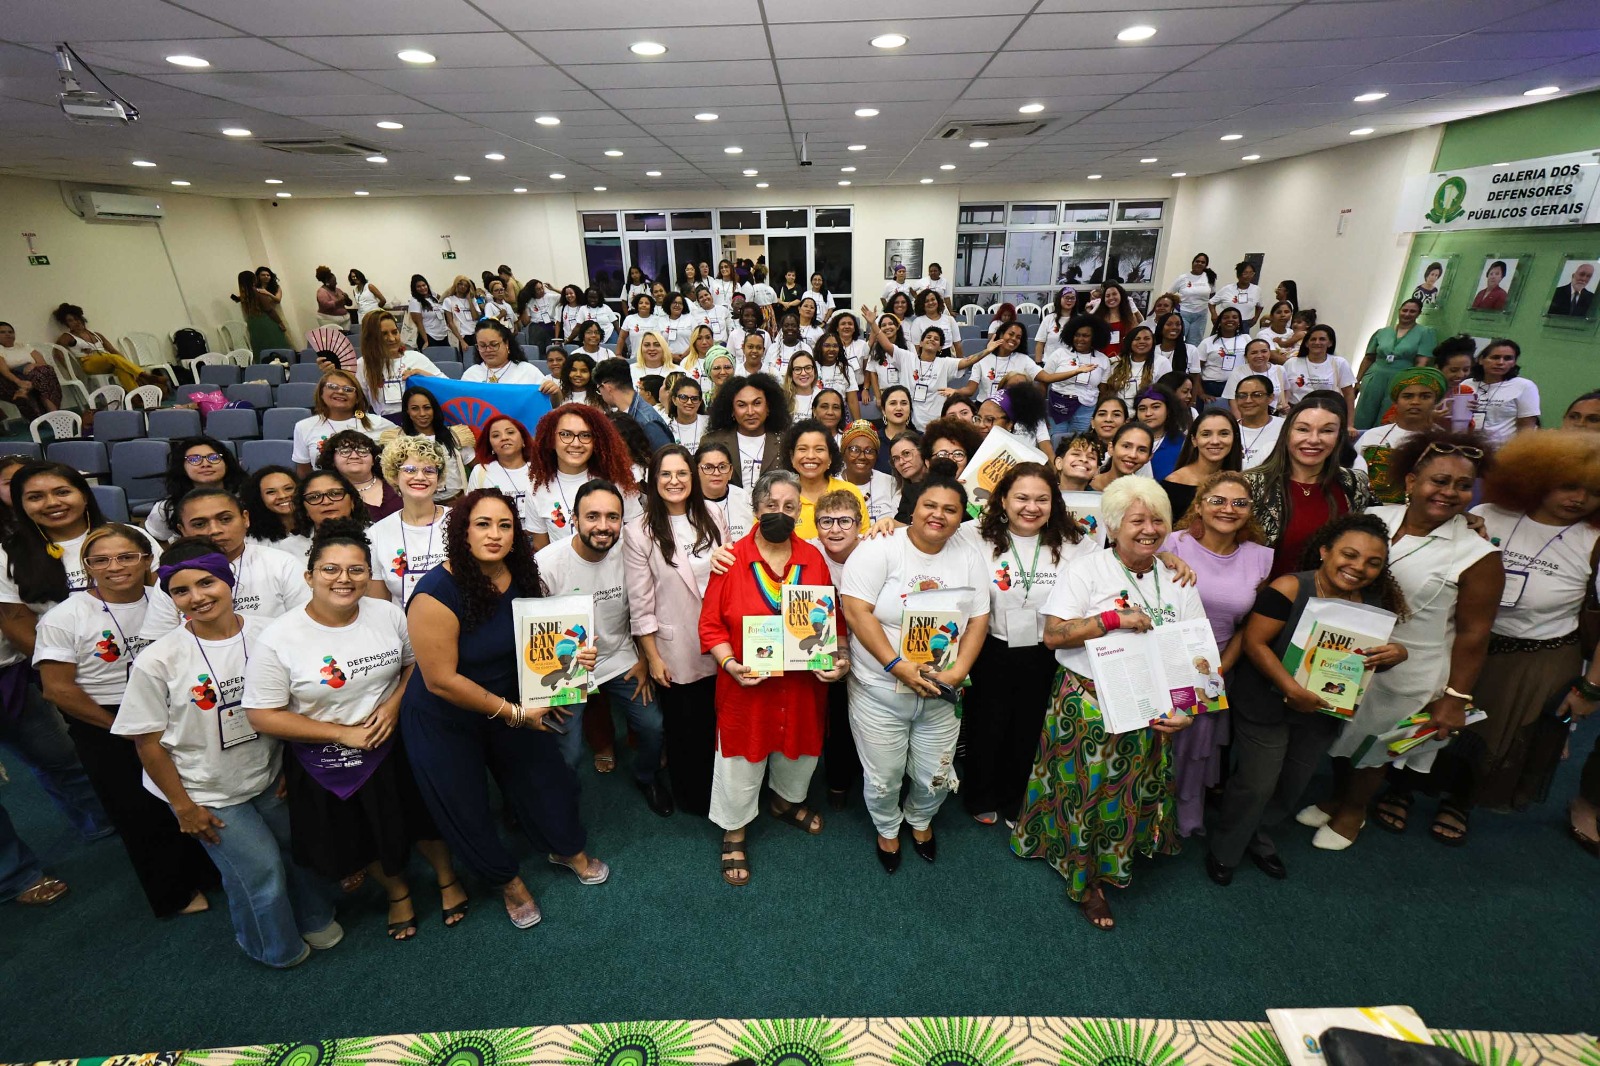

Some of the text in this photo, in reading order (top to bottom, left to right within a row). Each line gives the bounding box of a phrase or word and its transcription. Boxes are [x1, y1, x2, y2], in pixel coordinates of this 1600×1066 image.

[1492, 164, 1580, 184] GALERIA DOS
[1487, 184, 1573, 202] DEFENSORES
[1468, 203, 1584, 220] PÚBLICOS GERAIS
[1503, 550, 1560, 570] DEFENSORAS
[788, 590, 814, 603] ESPE
[789, 602, 809, 614] RAN
[530, 621, 562, 636] ESPE
[909, 616, 938, 629] ESPE
[530, 634, 555, 649] RAN
[908, 628, 930, 640] RAN
[1318, 630, 1355, 650] ESPE
[347, 648, 399, 668] DEFENSORAS
